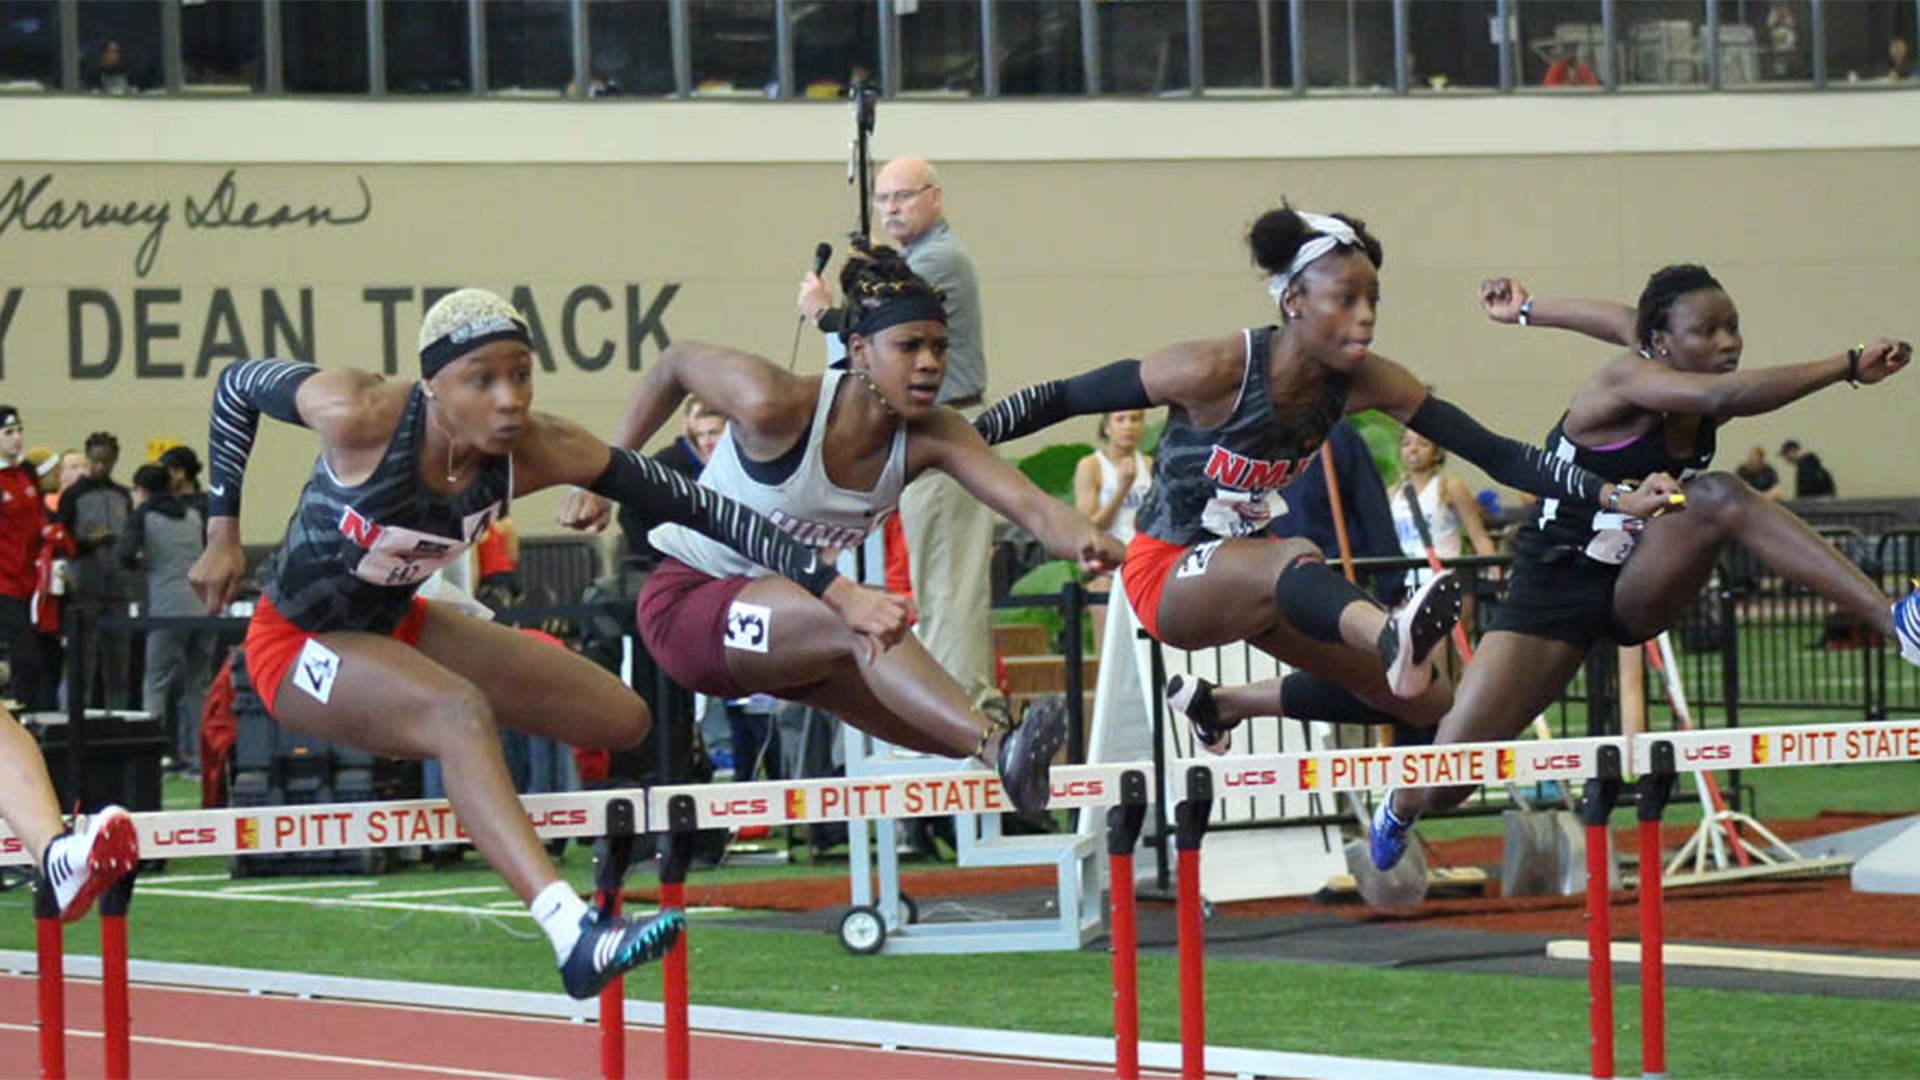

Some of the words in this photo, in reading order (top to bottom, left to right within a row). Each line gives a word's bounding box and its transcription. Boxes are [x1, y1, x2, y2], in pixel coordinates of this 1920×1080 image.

[185, 170, 371, 229] Dean
[67, 287, 317, 381] DEAN
[725, 614, 765, 646] 3
[1685, 745, 1732, 762] UCS
[1780, 731, 1837, 762] PITT
[1846, 727, 1920, 760] STATE
[1224, 770, 1277, 787] UCS
[1330, 755, 1392, 788] PITT
[1402, 750, 1484, 785] STATE
[1532, 754, 1582, 770] UCS
[710, 799, 768, 816] UCS
[820, 784, 892, 817] PITT
[904, 777, 1001, 814] STATE
[1050, 781, 1104, 798] UCS
[153, 828, 216, 846] UCS
[275, 812, 353, 847] PITT
